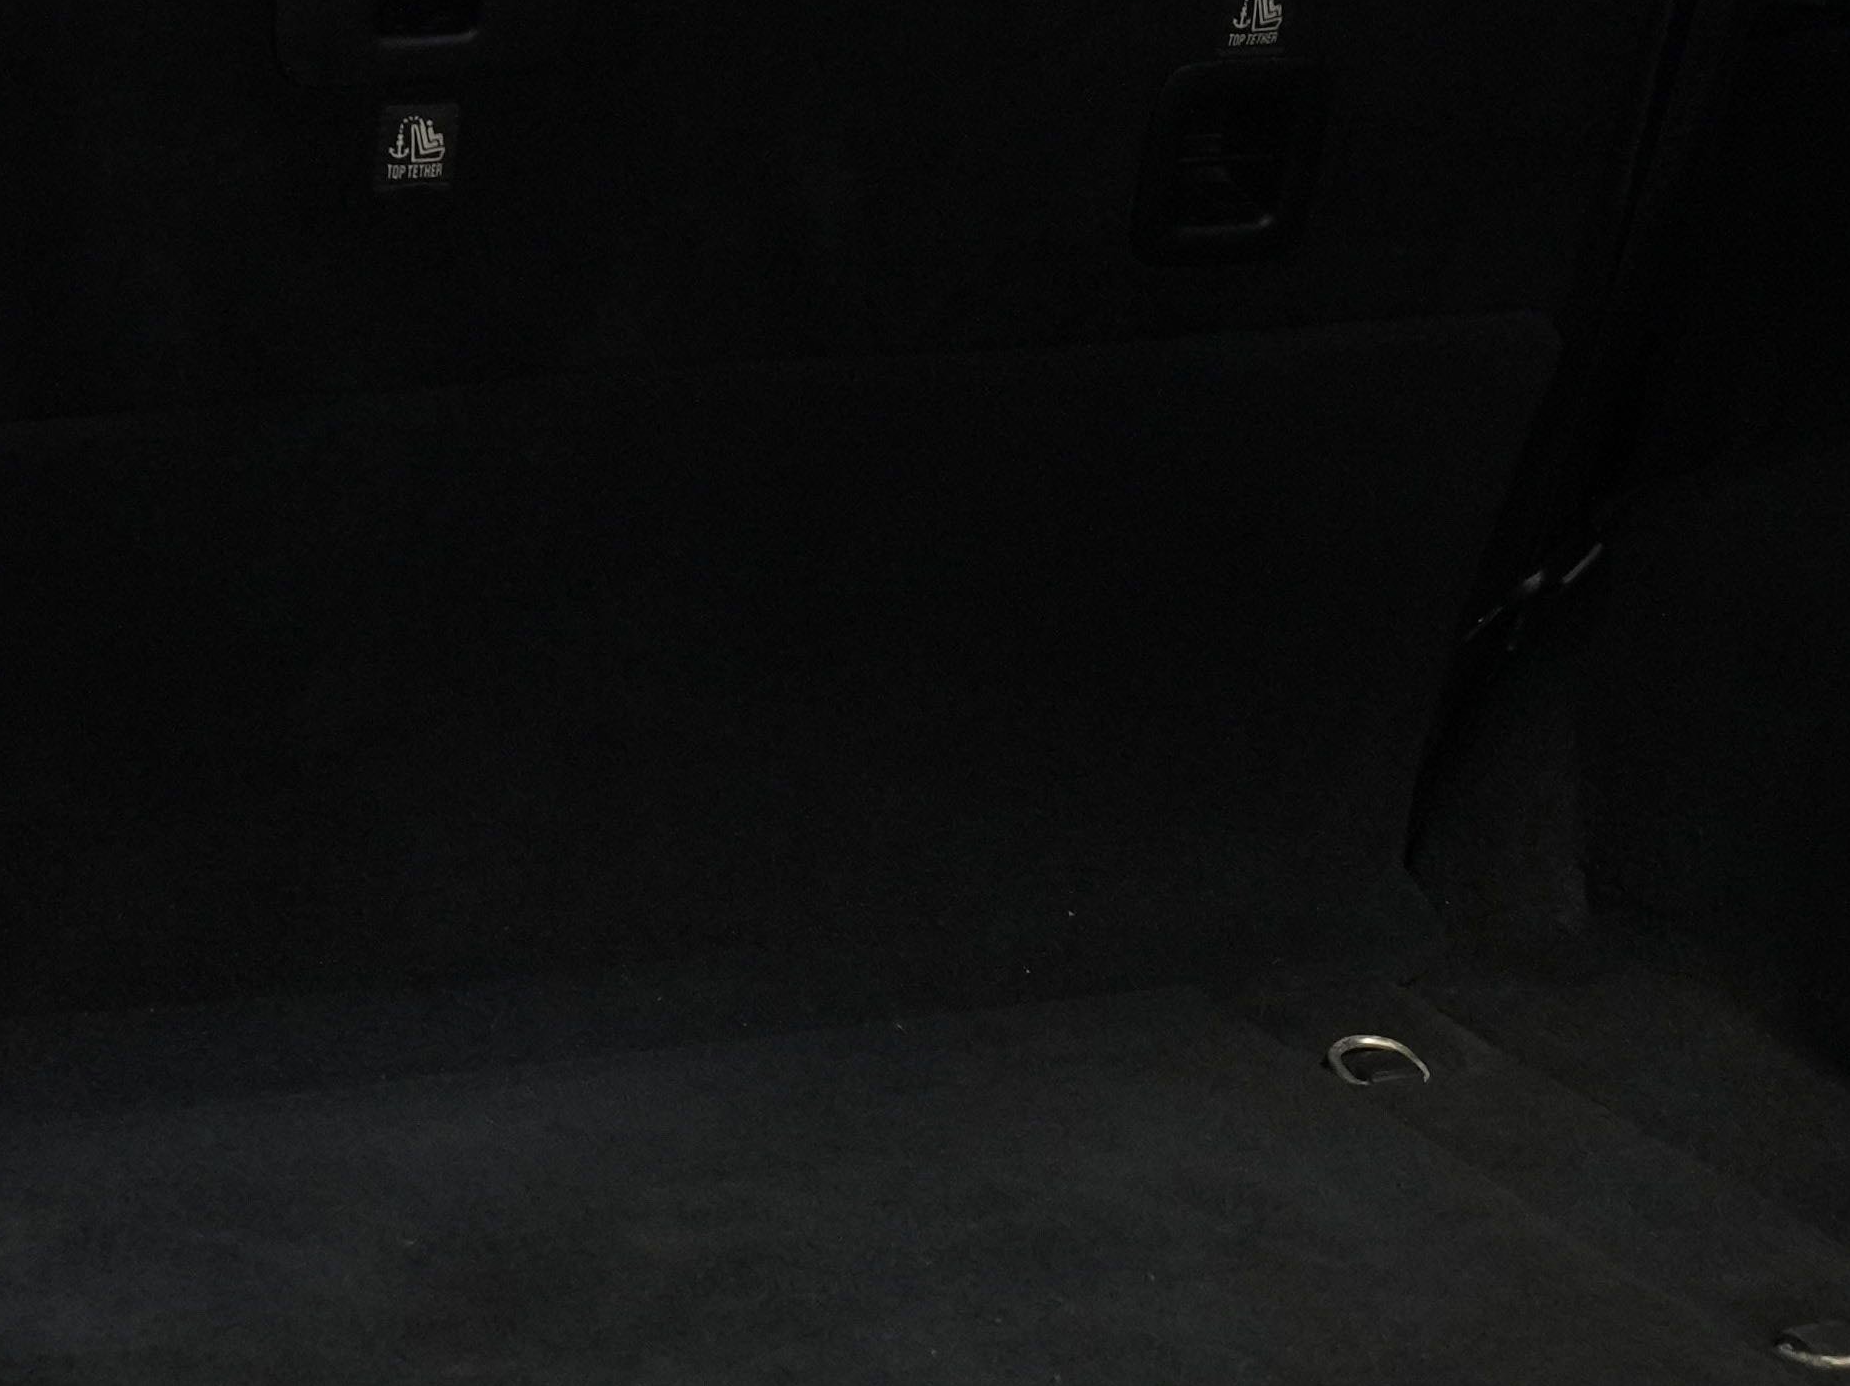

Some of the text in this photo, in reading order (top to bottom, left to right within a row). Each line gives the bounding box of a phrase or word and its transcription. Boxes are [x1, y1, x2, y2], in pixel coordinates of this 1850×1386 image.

[1229, 33, 1246, 46] TOP
[387, 163, 443, 180] TOP TETHER
